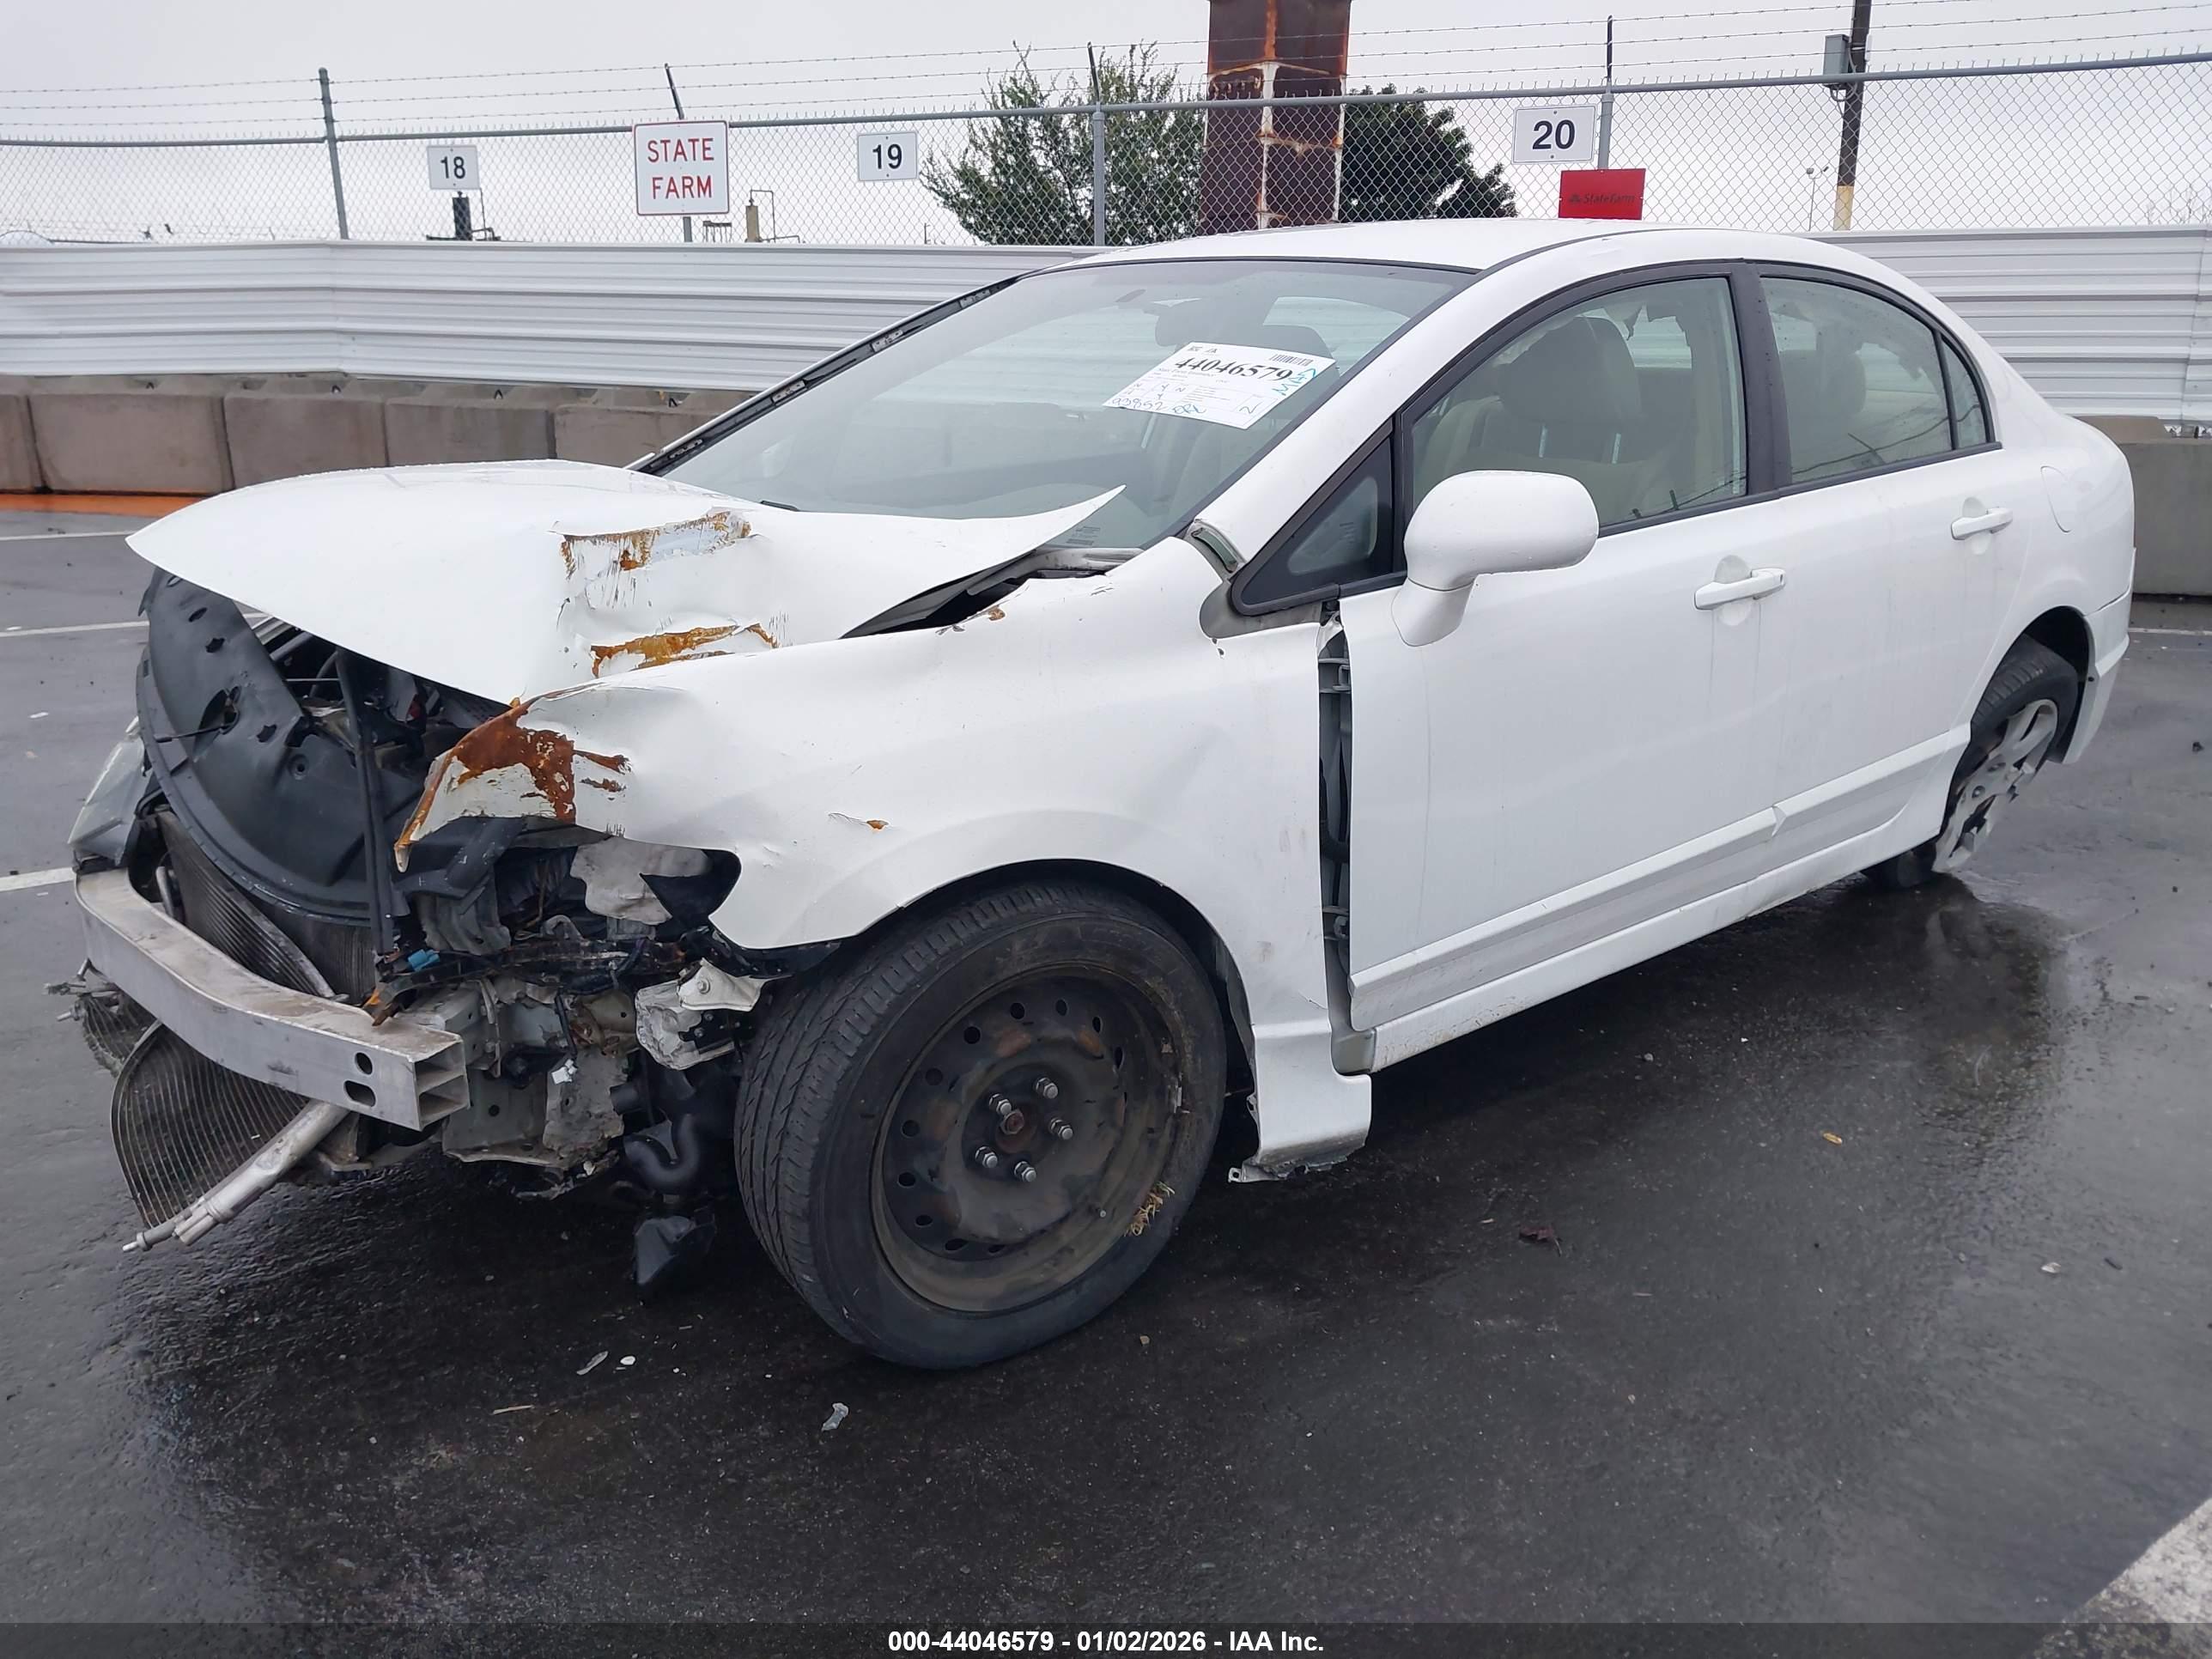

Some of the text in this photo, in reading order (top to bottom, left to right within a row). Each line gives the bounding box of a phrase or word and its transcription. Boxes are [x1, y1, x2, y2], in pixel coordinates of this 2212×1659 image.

[1532, 119, 1576, 150] 20
[647, 138, 714, 162] STATE
[872, 143, 903, 170] 19
[441, 156, 466, 179] 18
[652, 176, 713, 199] FARM
[1175, 357, 1293, 381] 44046579
